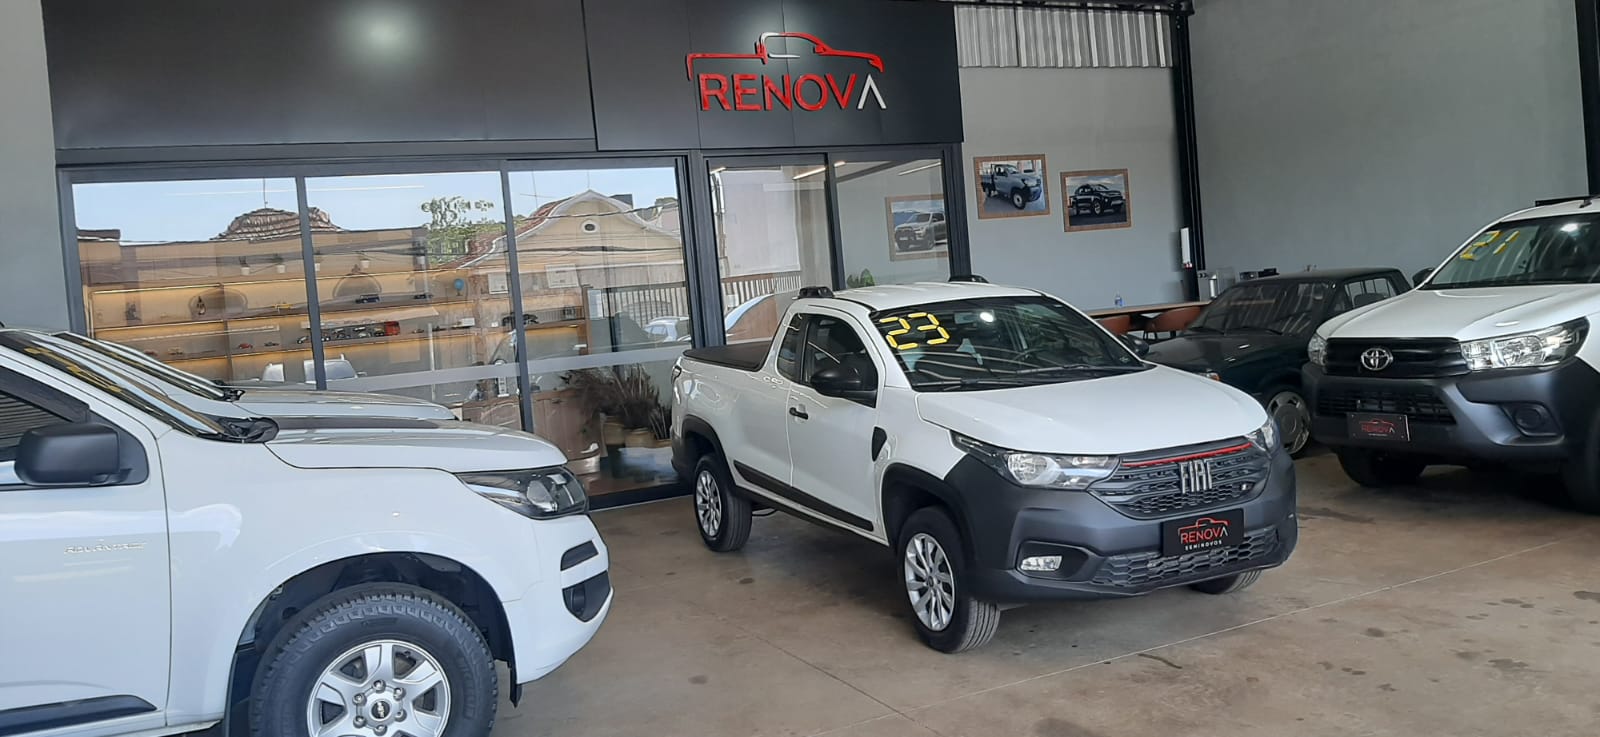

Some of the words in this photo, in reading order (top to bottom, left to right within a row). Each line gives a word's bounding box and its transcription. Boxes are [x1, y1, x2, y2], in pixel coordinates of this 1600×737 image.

[699, 73, 887, 111] RENOVA
[1460, 230, 1520, 260] 21
[879, 312, 951, 350] 23
[1180, 459, 1213, 494] FIAT
[1180, 526, 1229, 545] RENOVA
[1185, 540, 1222, 551] SEMINOVOS
